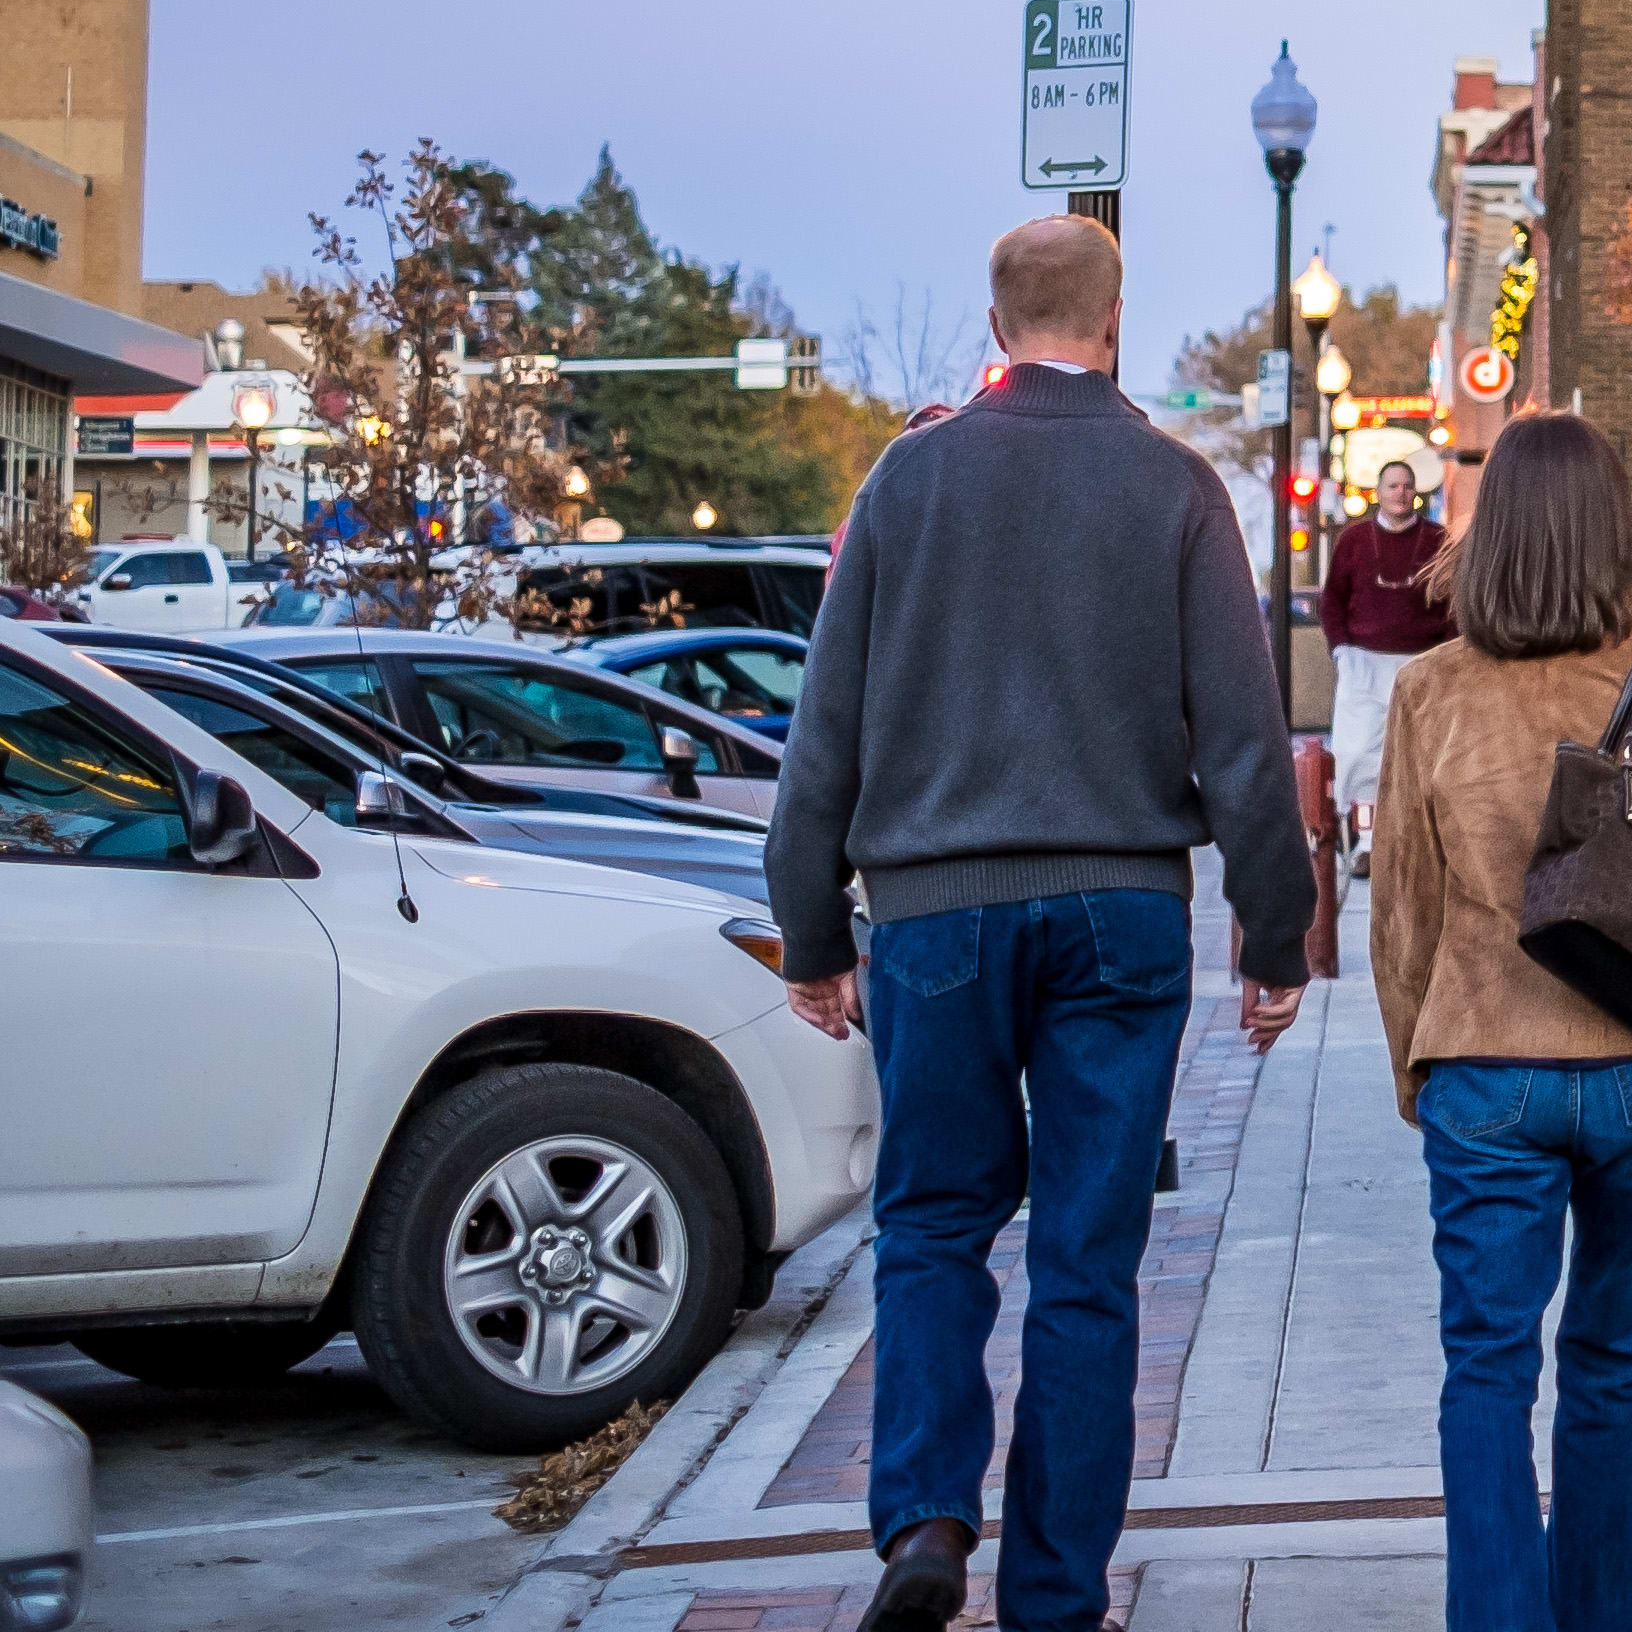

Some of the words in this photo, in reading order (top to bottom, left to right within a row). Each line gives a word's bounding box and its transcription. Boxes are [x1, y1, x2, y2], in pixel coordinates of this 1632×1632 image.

[1075, 5, 1104, 30] HR
[1031, 12, 1053, 56] 2
[1060, 32, 1123, 60] PARKING
